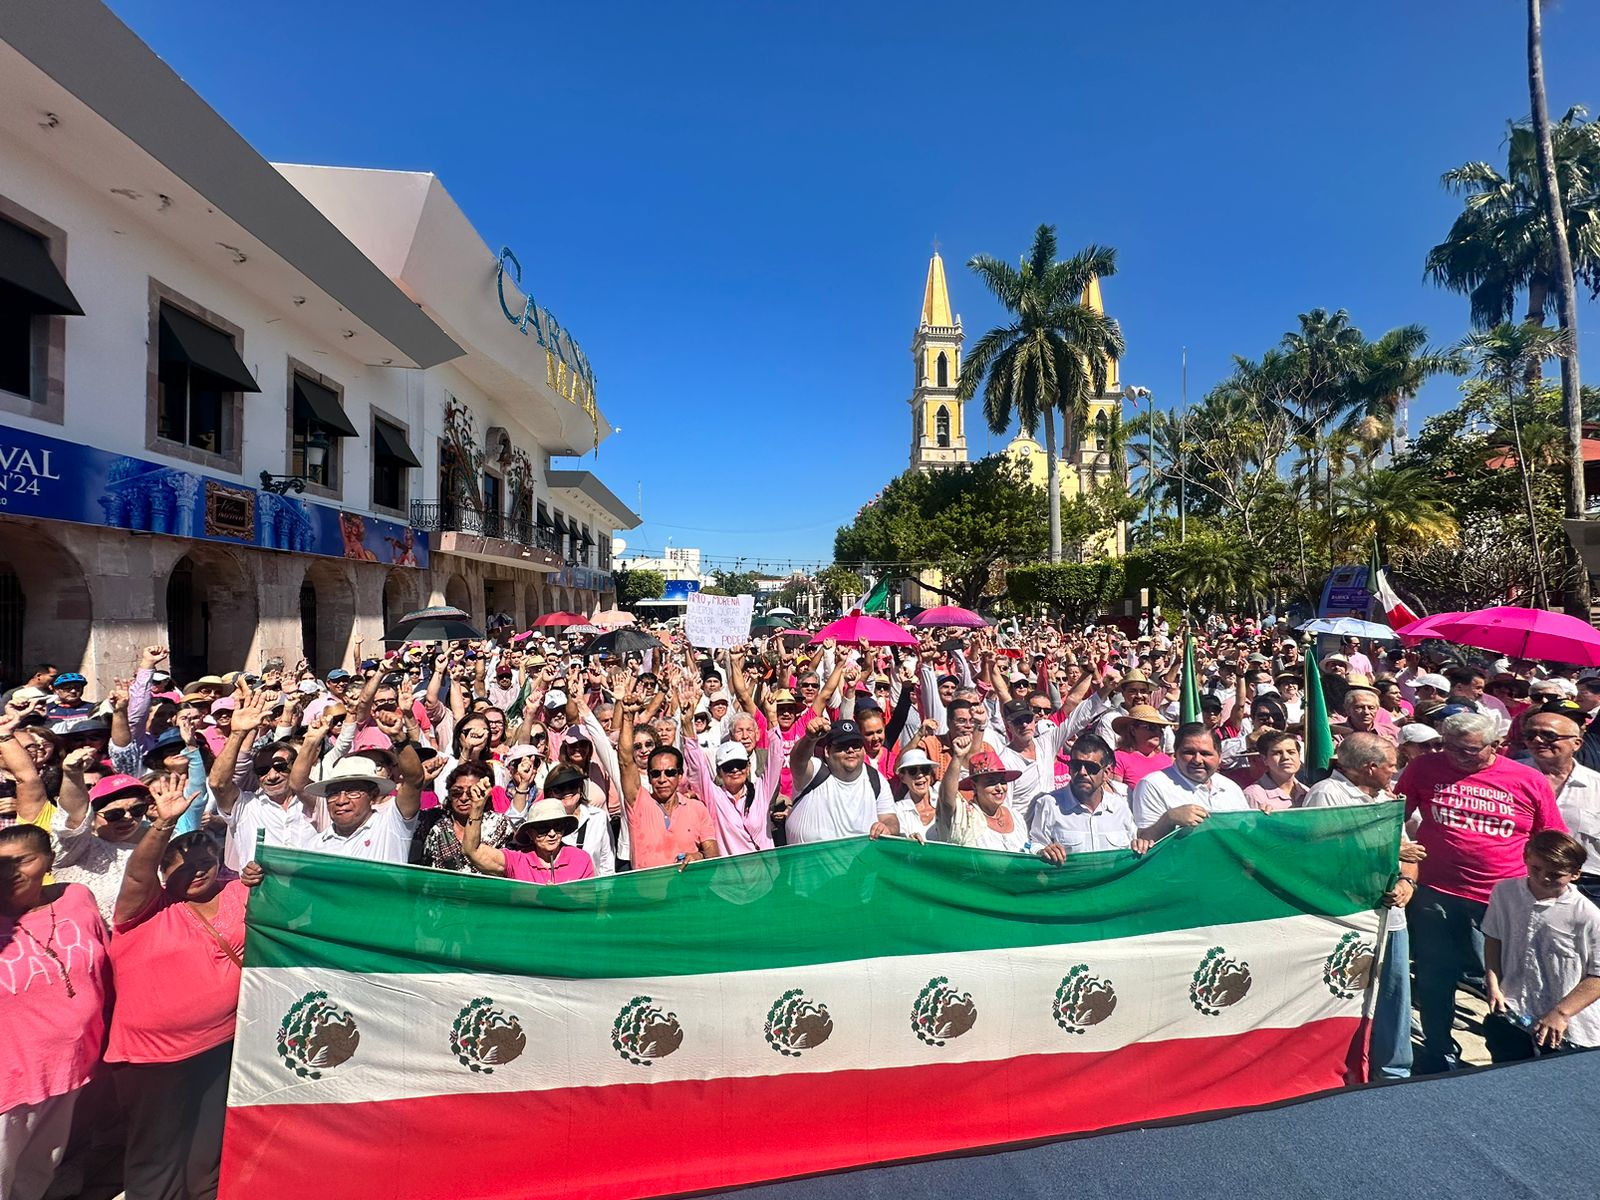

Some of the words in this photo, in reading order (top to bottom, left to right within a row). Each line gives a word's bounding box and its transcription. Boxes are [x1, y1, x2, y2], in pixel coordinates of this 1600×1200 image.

[721, 634, 747, 646] PODER
[1434, 783, 1443, 792] SI
[1445, 783, 1457, 793] TE
[1459, 785, 1514, 803] PREOCUPA
[1432, 793, 1444, 804] EL
[1449, 796, 1496, 813] FUTURO
[1499, 803, 1515, 816] DE
